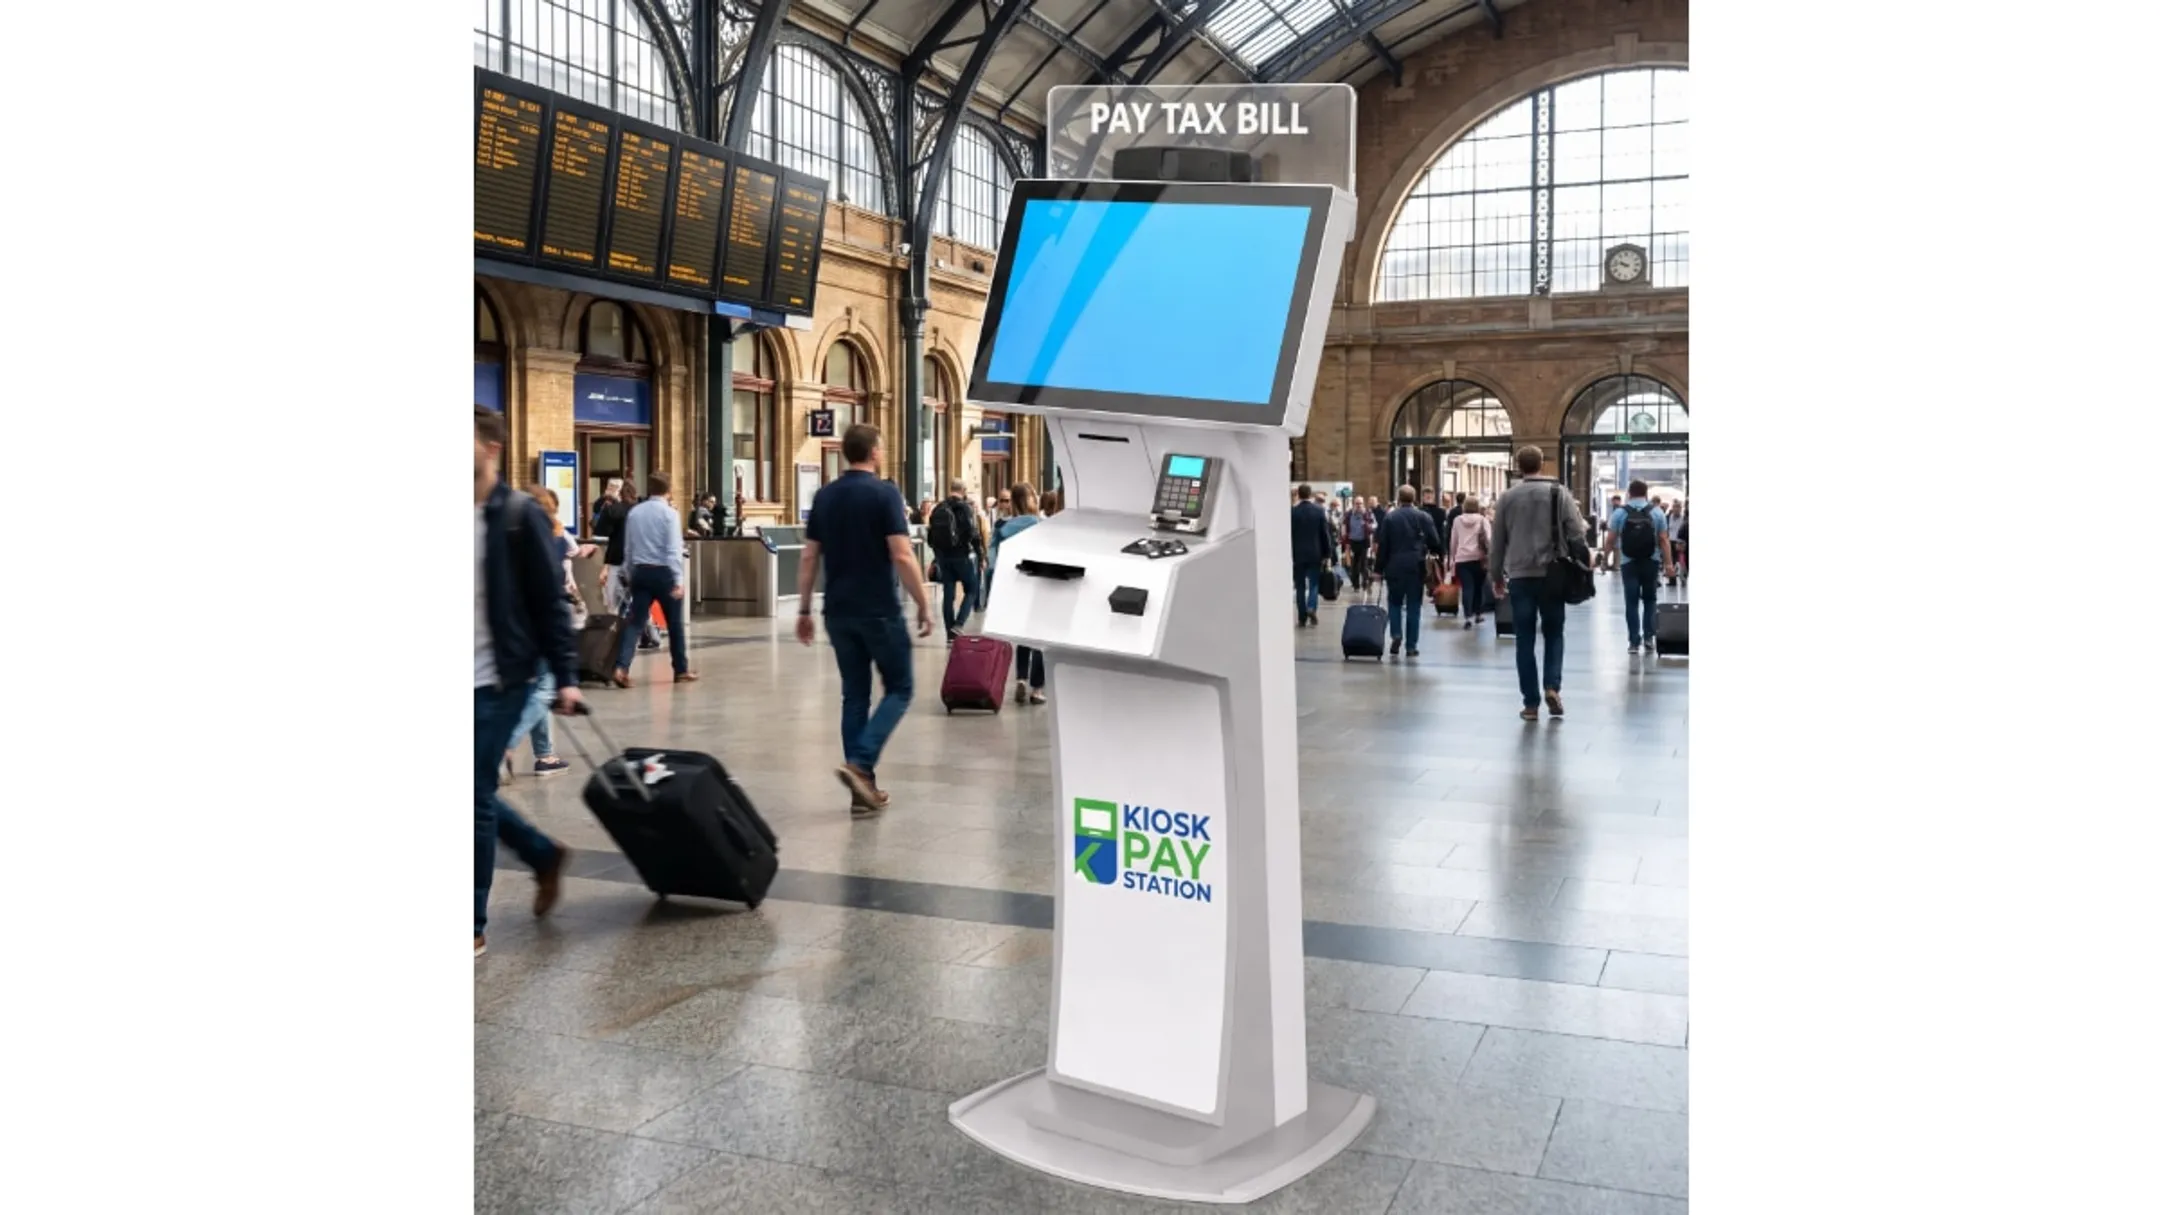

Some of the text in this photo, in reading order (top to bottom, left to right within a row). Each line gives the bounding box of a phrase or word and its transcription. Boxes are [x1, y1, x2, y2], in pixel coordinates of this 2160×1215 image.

[1090, 102, 1309, 135] PAY TAX BILL
[1123, 804, 1211, 841] KIOSK
[1123, 831, 1211, 880] PAY
[1123, 871, 1211, 903] STATION
